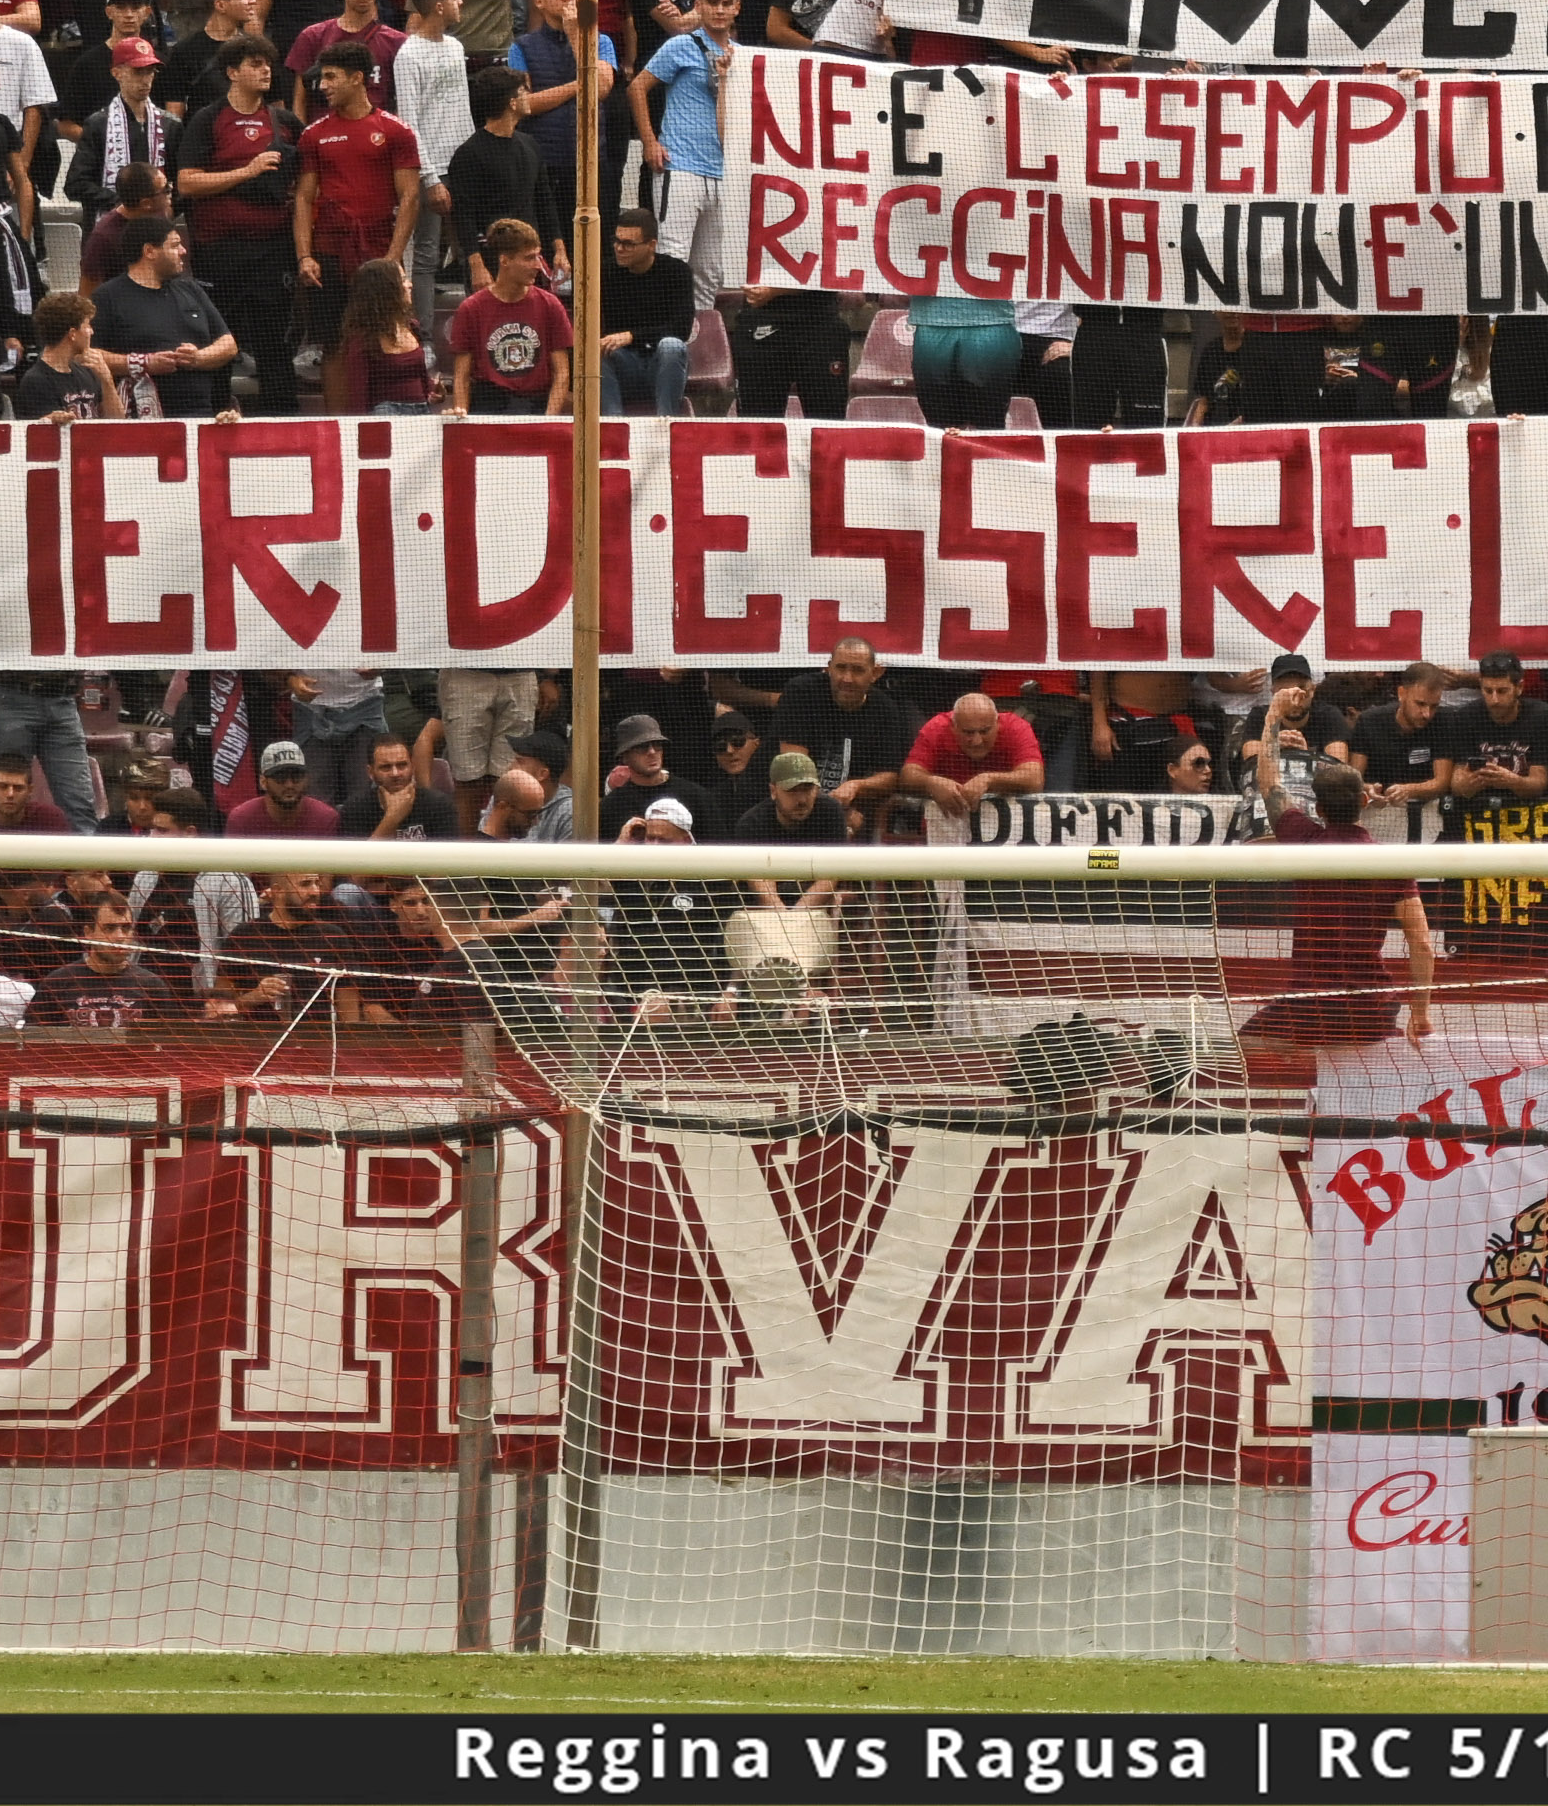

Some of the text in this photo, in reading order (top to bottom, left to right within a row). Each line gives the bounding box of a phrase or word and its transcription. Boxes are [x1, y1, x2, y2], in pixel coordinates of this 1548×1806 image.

[749, 55, 871, 174] NE
[1181, 200, 1359, 314] NON
[487, 323, 521, 351] CURVA
[668, 421, 1430, 664] ESSERE
[272, 749, 297, 765] NYC
[1346, 1471, 1470, 1554] Cur
